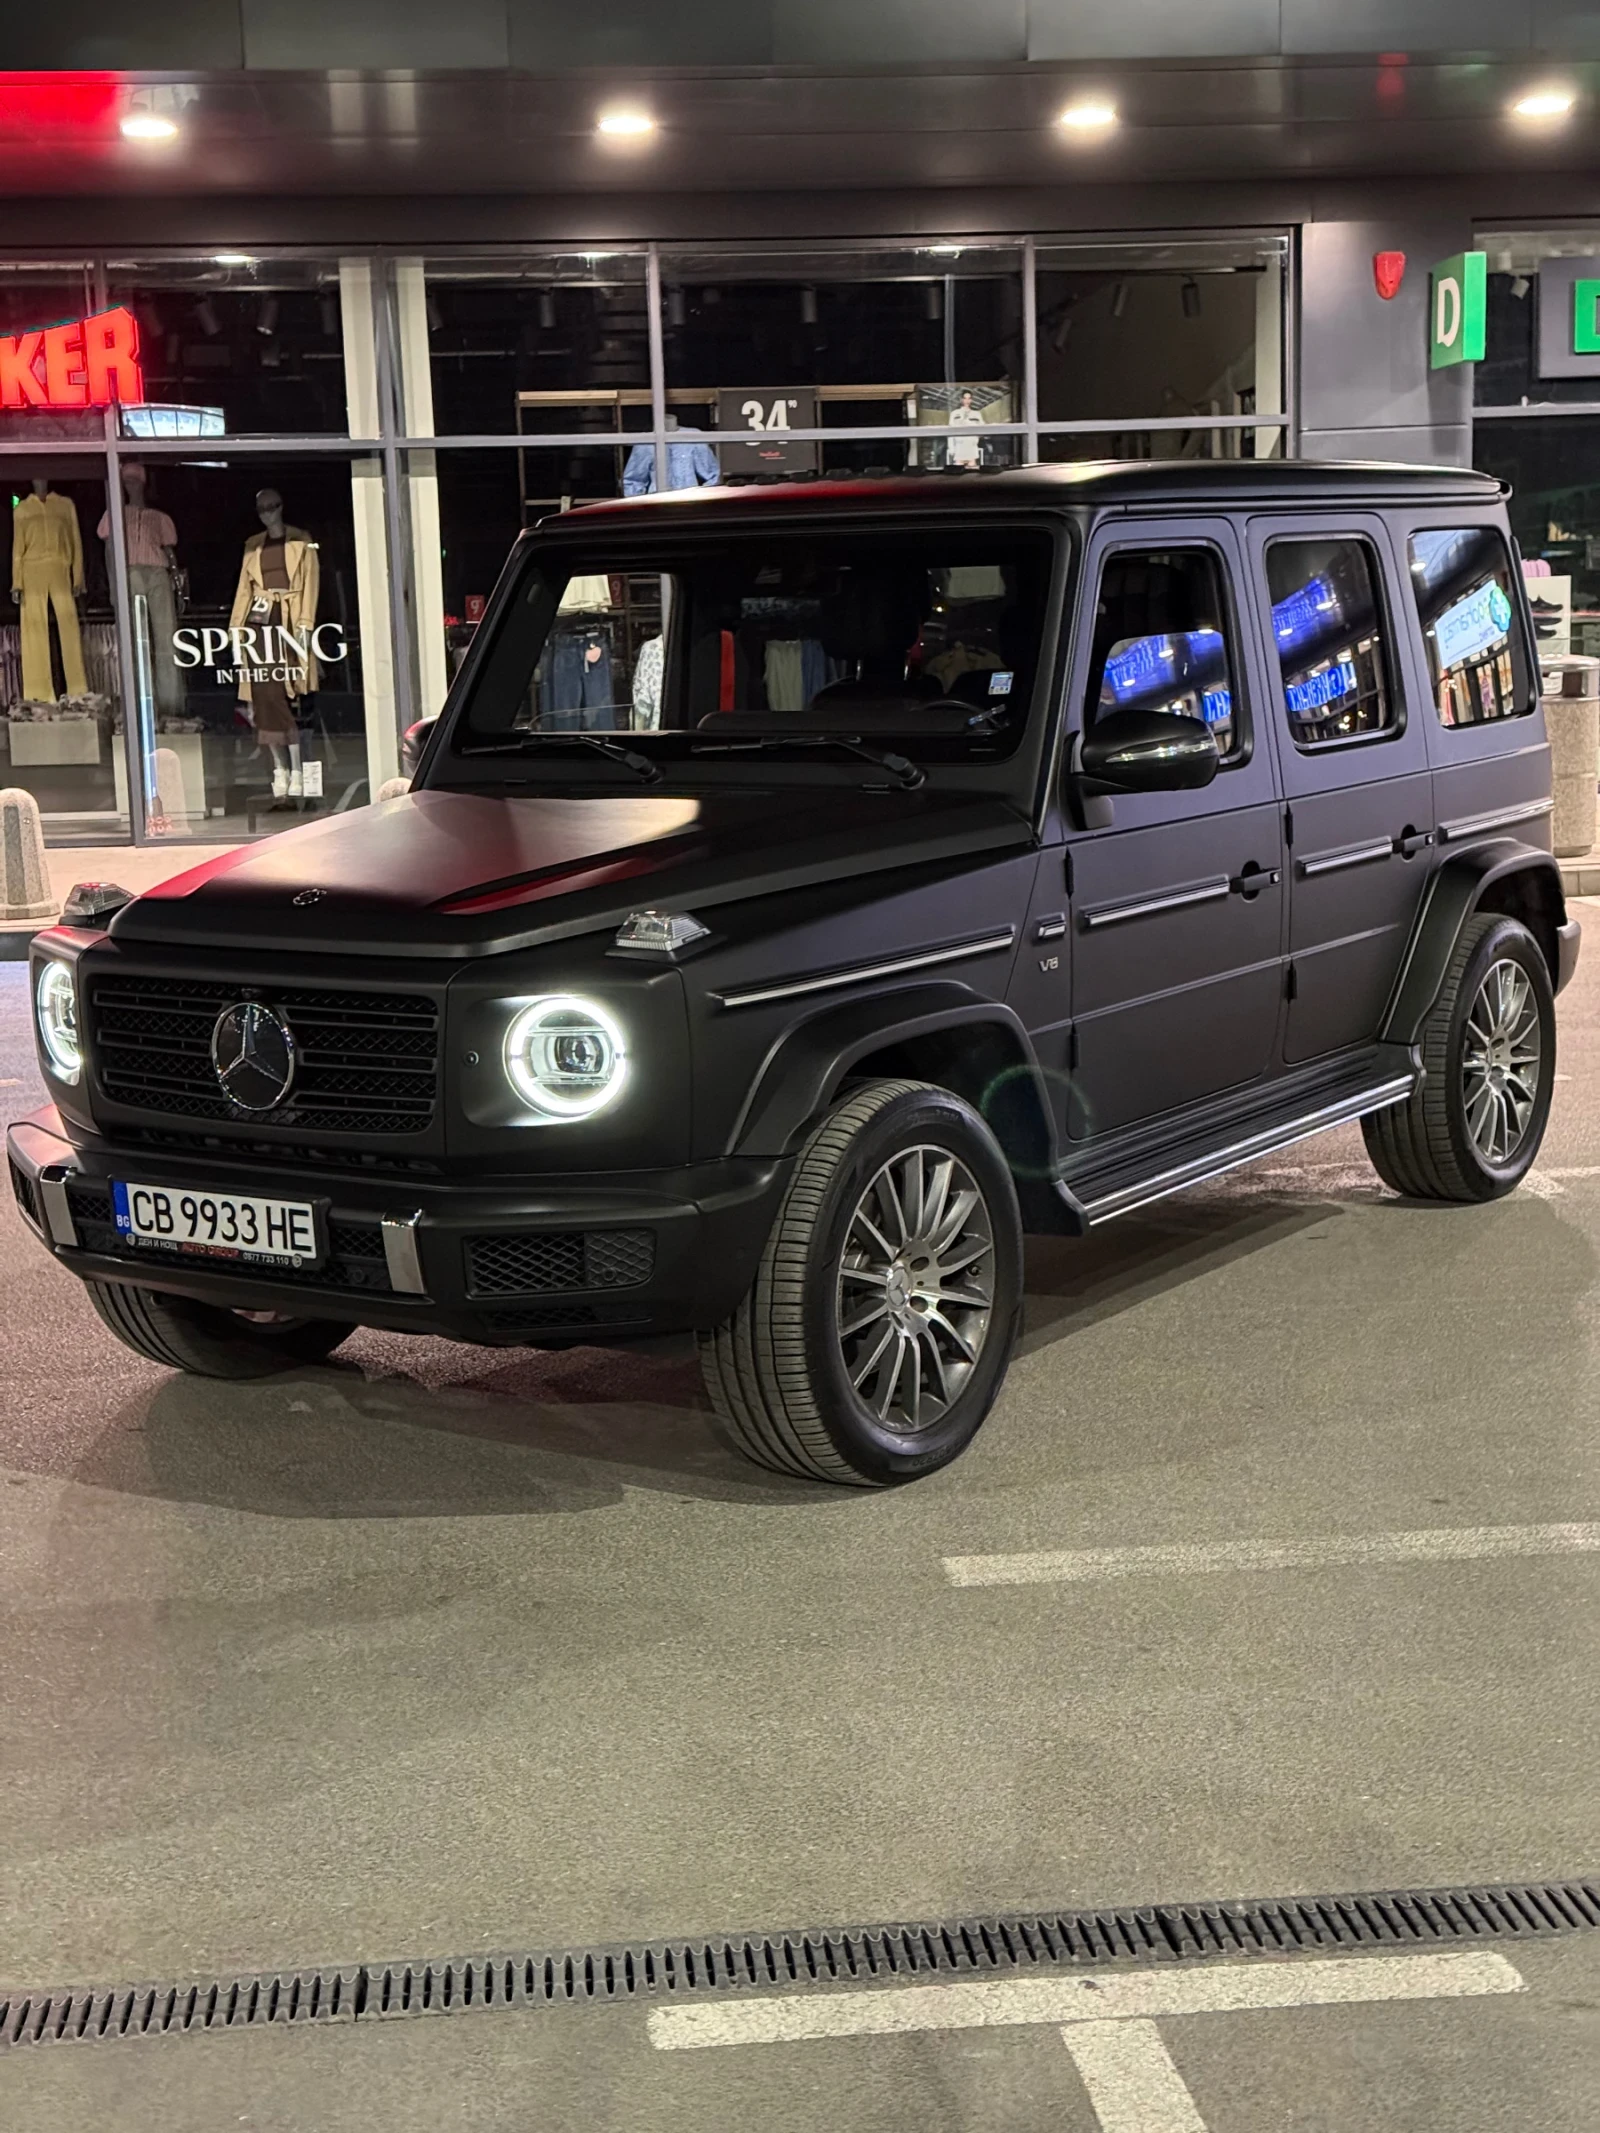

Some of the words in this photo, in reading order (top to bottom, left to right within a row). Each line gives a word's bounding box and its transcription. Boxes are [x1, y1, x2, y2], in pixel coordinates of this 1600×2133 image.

[1436, 277, 1461, 347] D
[741, 400, 790, 446] 34
[172, 623, 348, 667] SPRING
[216, 669, 233, 684] IN
[235, 667, 269, 683] THE
[271, 666, 308, 682] CITY
[116, 1214, 130, 1228] BG
[133, 1190, 174, 1234] CB
[180, 1196, 259, 1245] 9933
[265, 1205, 312, 1252] HE
